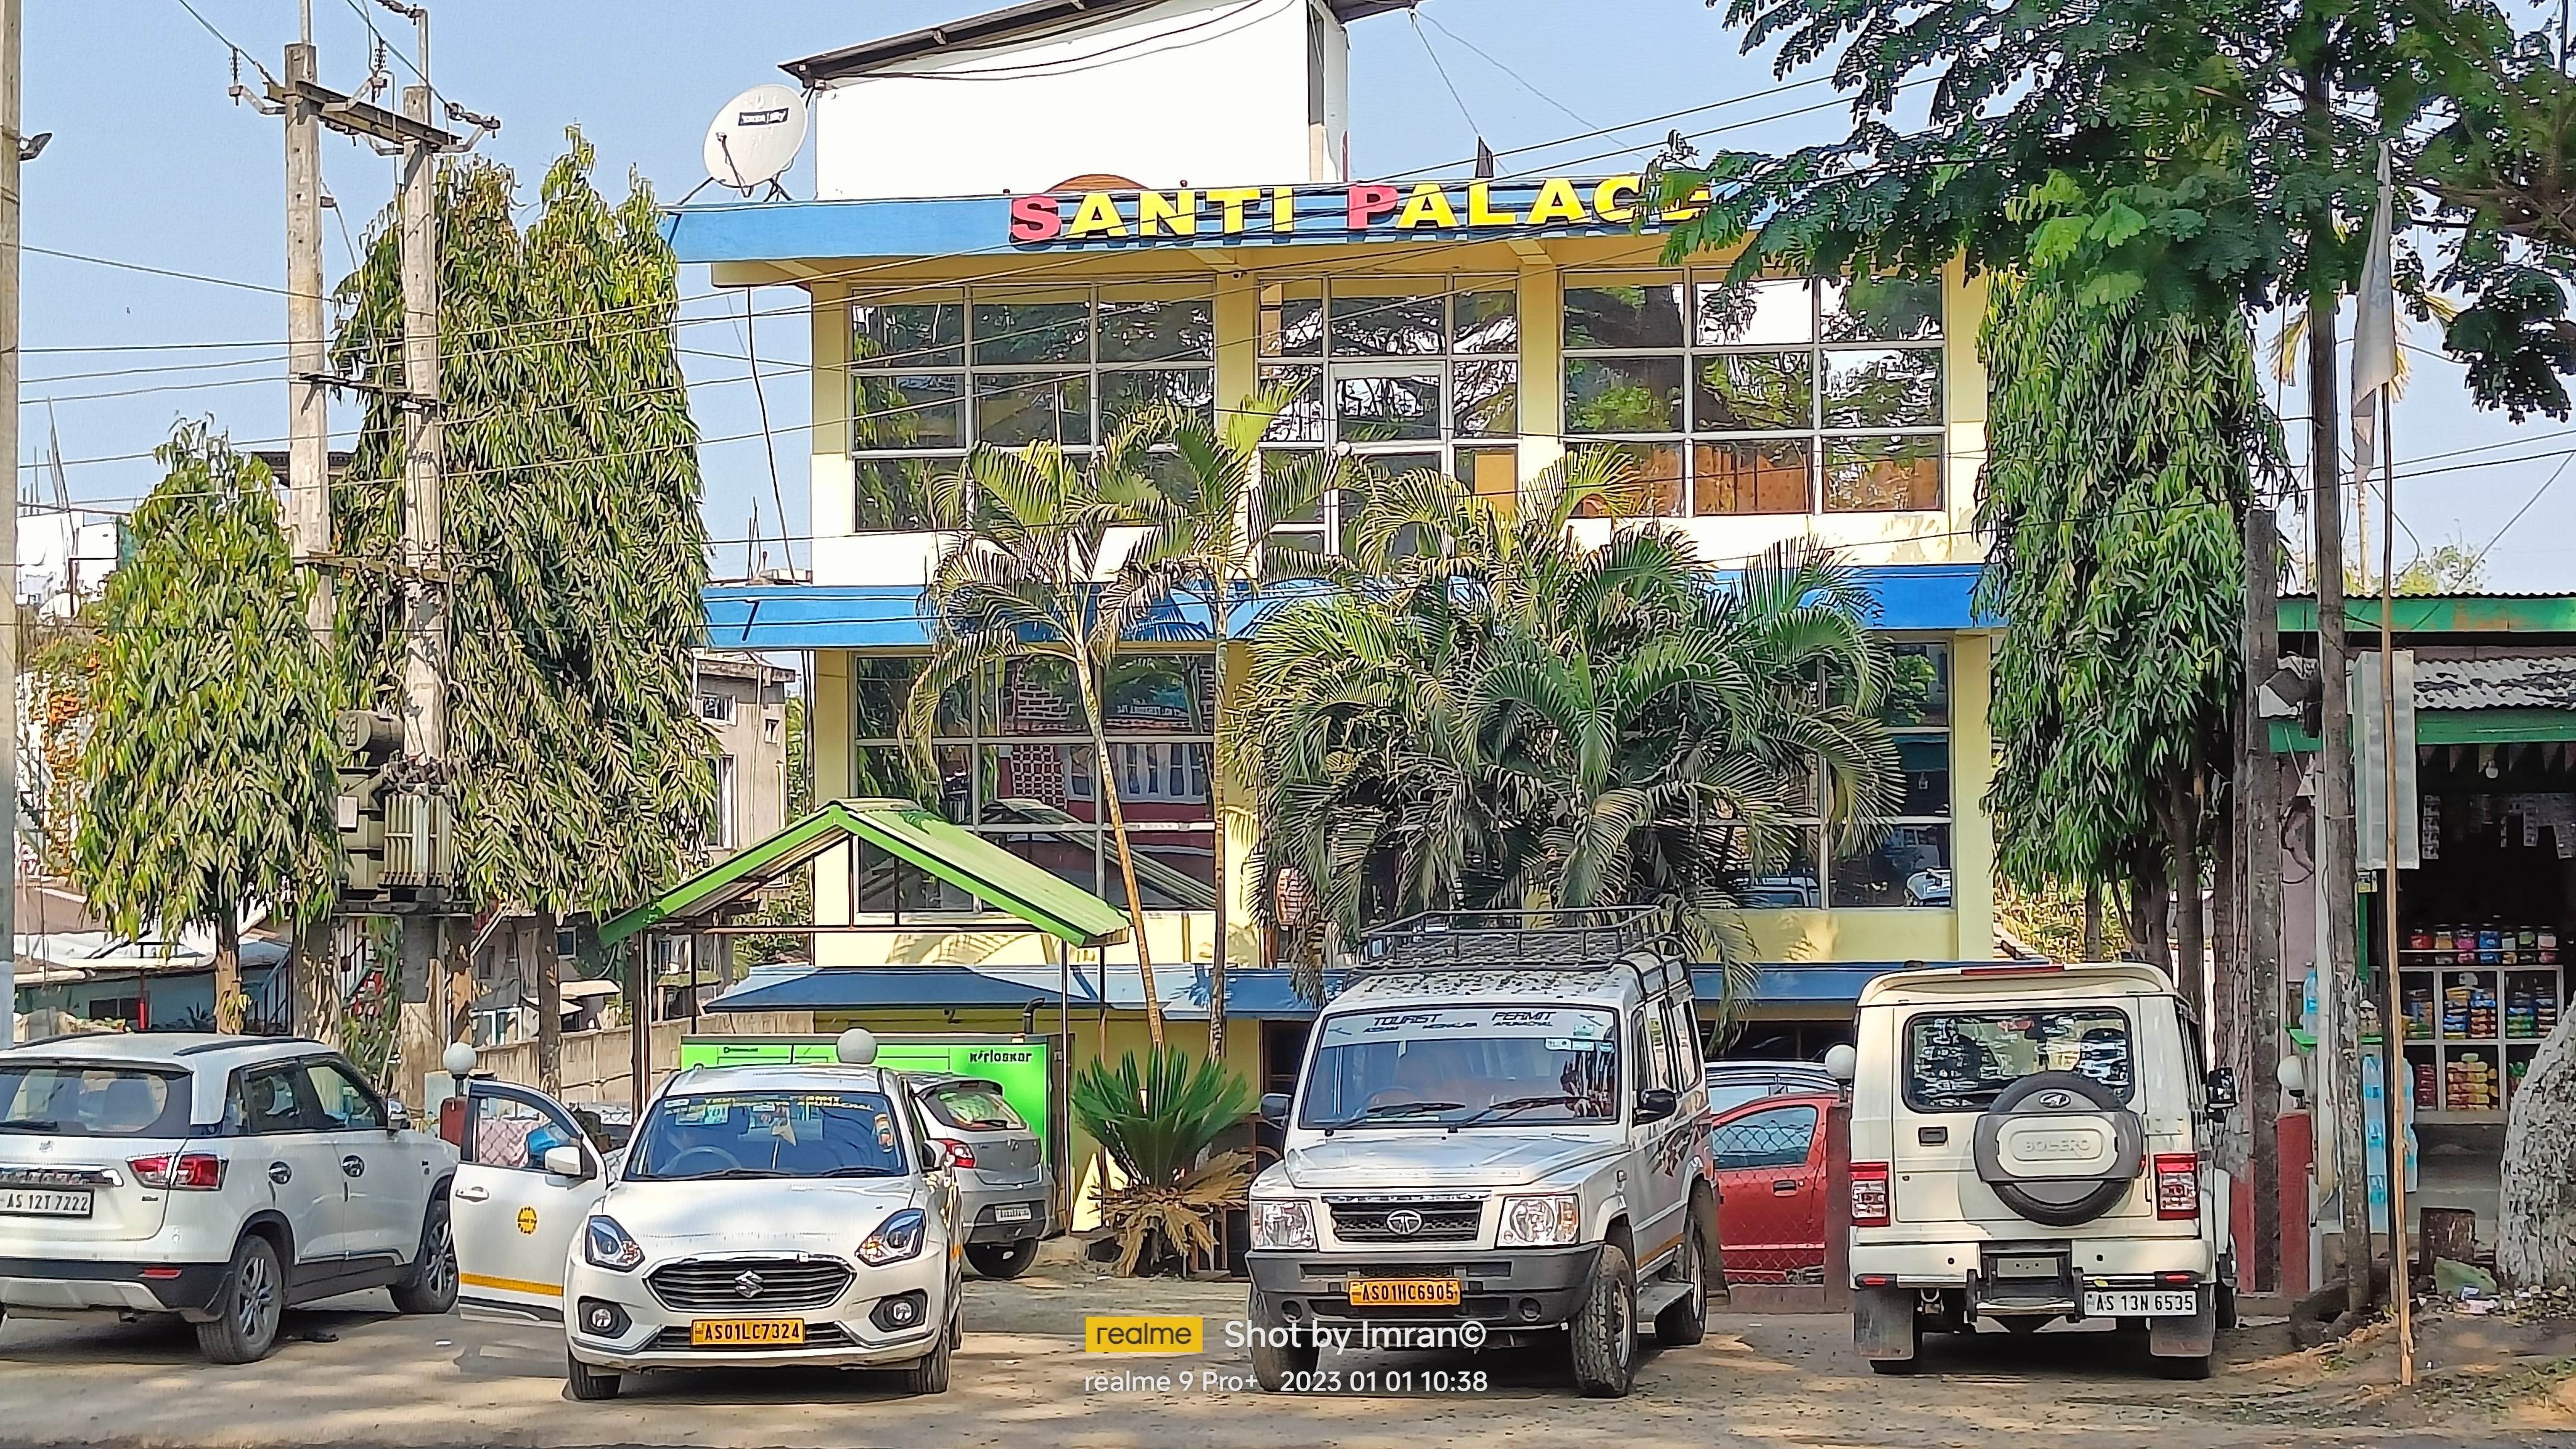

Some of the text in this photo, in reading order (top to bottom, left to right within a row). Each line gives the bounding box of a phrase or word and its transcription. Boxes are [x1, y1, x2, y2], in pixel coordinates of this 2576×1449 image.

[1010, 188, 1294, 241] SANTI
[1374, 1011, 1557, 1026] TOURIST PERMIT
[2024, 1139, 2092, 1156] BOLERO
[7, 1193, 23, 1208] AS
[55, 1195, 88, 1211] 7222
[2096, 1294, 2194, 1311] AS 13N 6535
[705, 1323, 800, 1341] AS01LC7324
